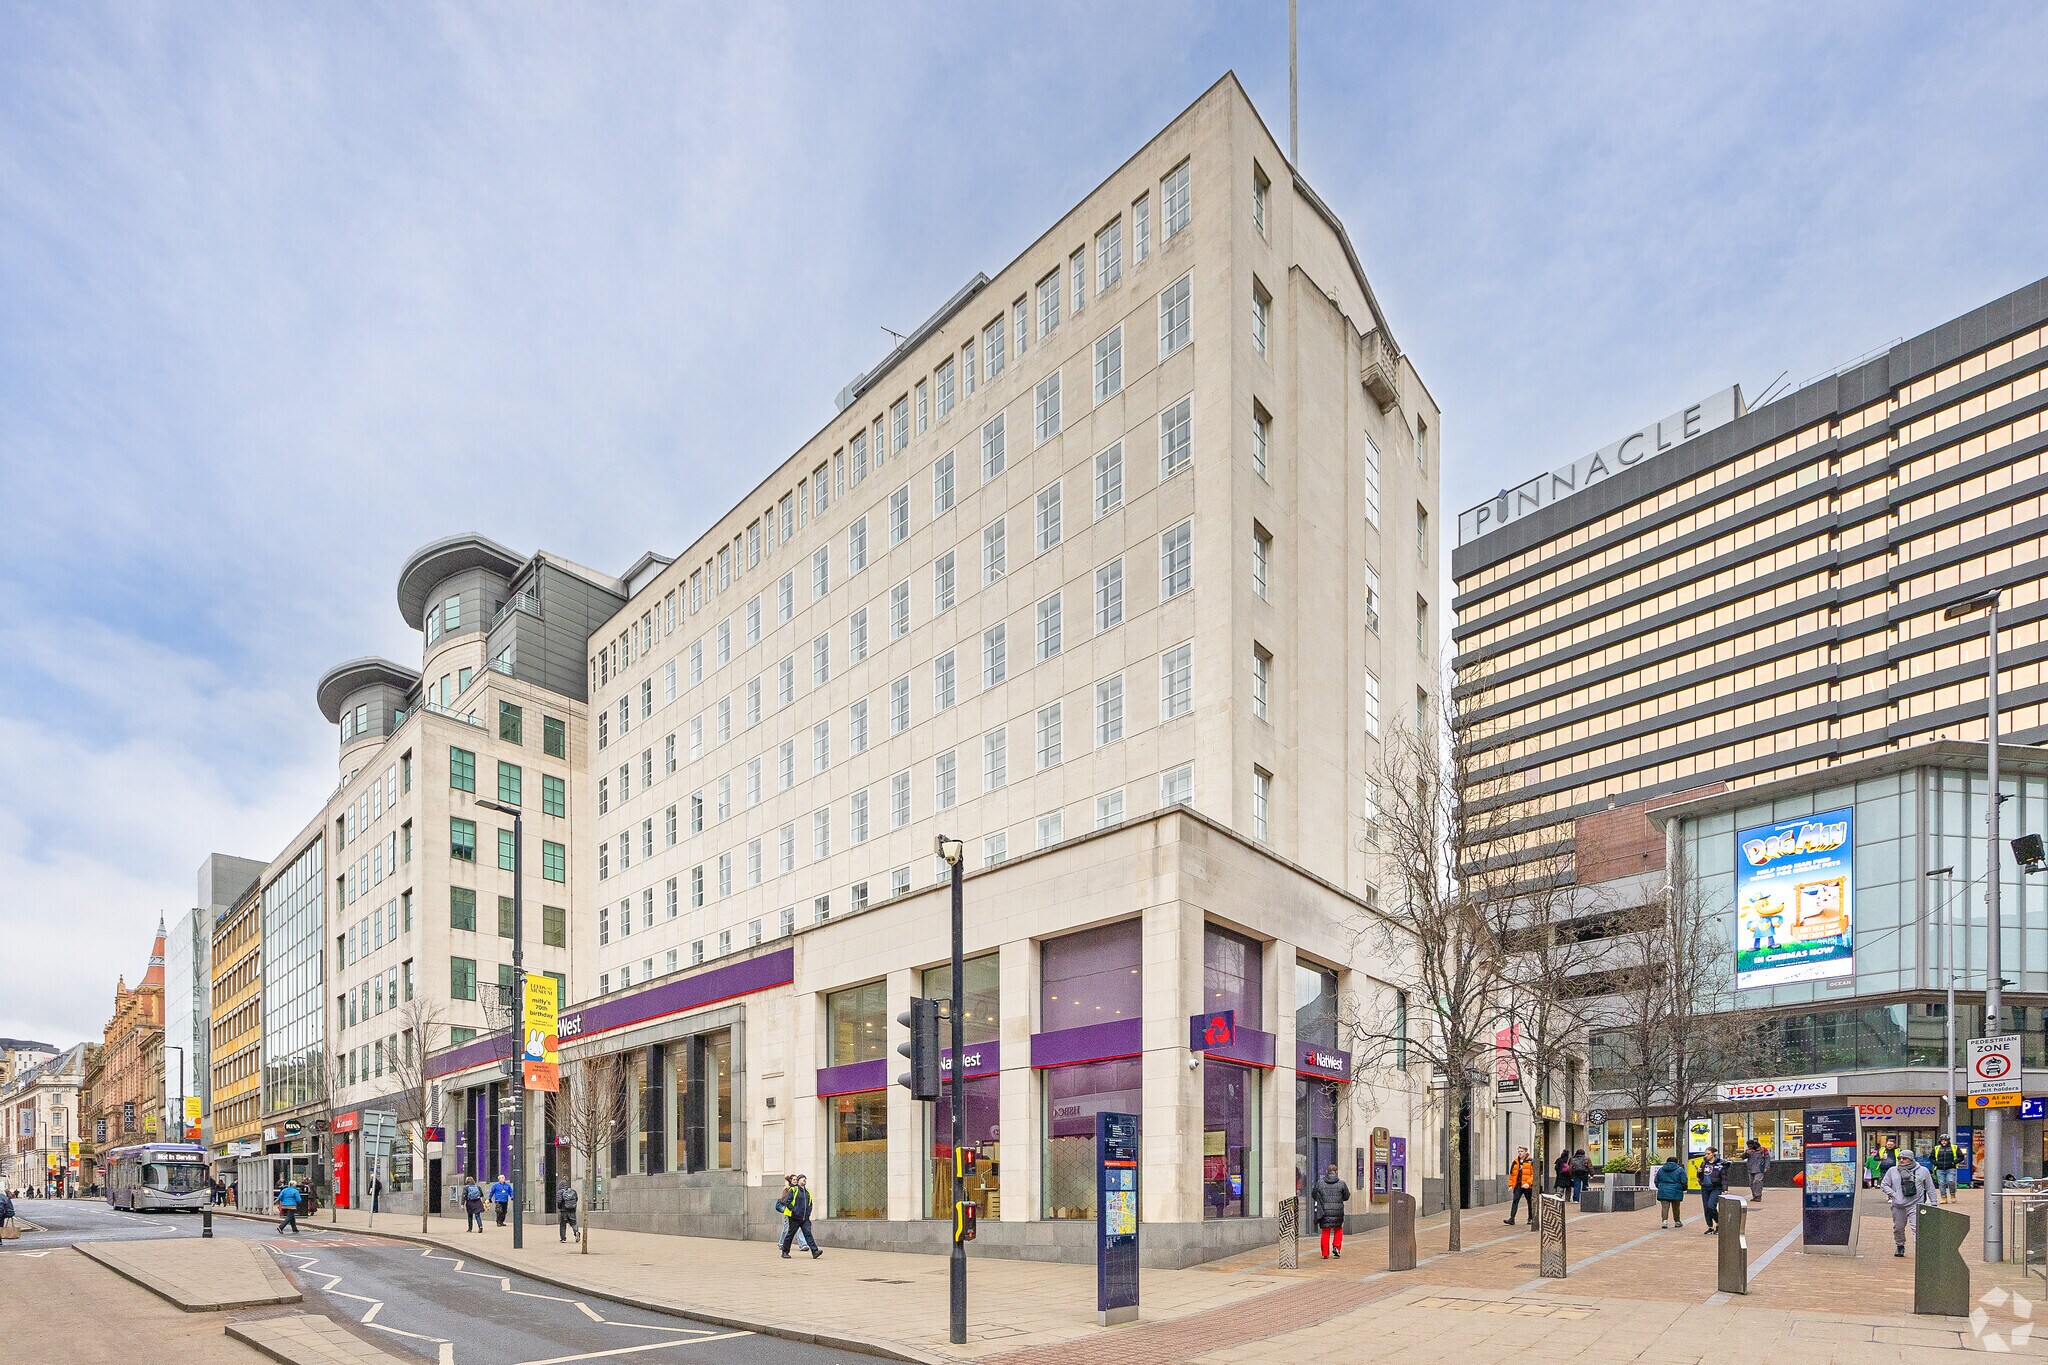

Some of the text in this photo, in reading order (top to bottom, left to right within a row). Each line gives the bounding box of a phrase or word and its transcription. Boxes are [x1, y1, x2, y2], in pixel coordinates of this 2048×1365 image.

[1476, 403, 1701, 534] PINNACLE
[1765, 950, 1808, 962] CINEMAS
[1809, 946, 1835, 956] NOW
[532, 998, 551, 1006] miffy's
[535, 1004, 548, 1012] 70th
[529, 1010, 554, 1019] birthday
[1970, 1036, 2017, 1045] PEDESTRIAN
[1977, 1043, 2010, 1053] ZONE
[1316, 1052, 1343, 1071] NatWest
[1727, 1080, 1828, 1095] TESCO express
[1895, 1104, 1936, 1118] express
[2022, 1101, 2031, 1114] P
